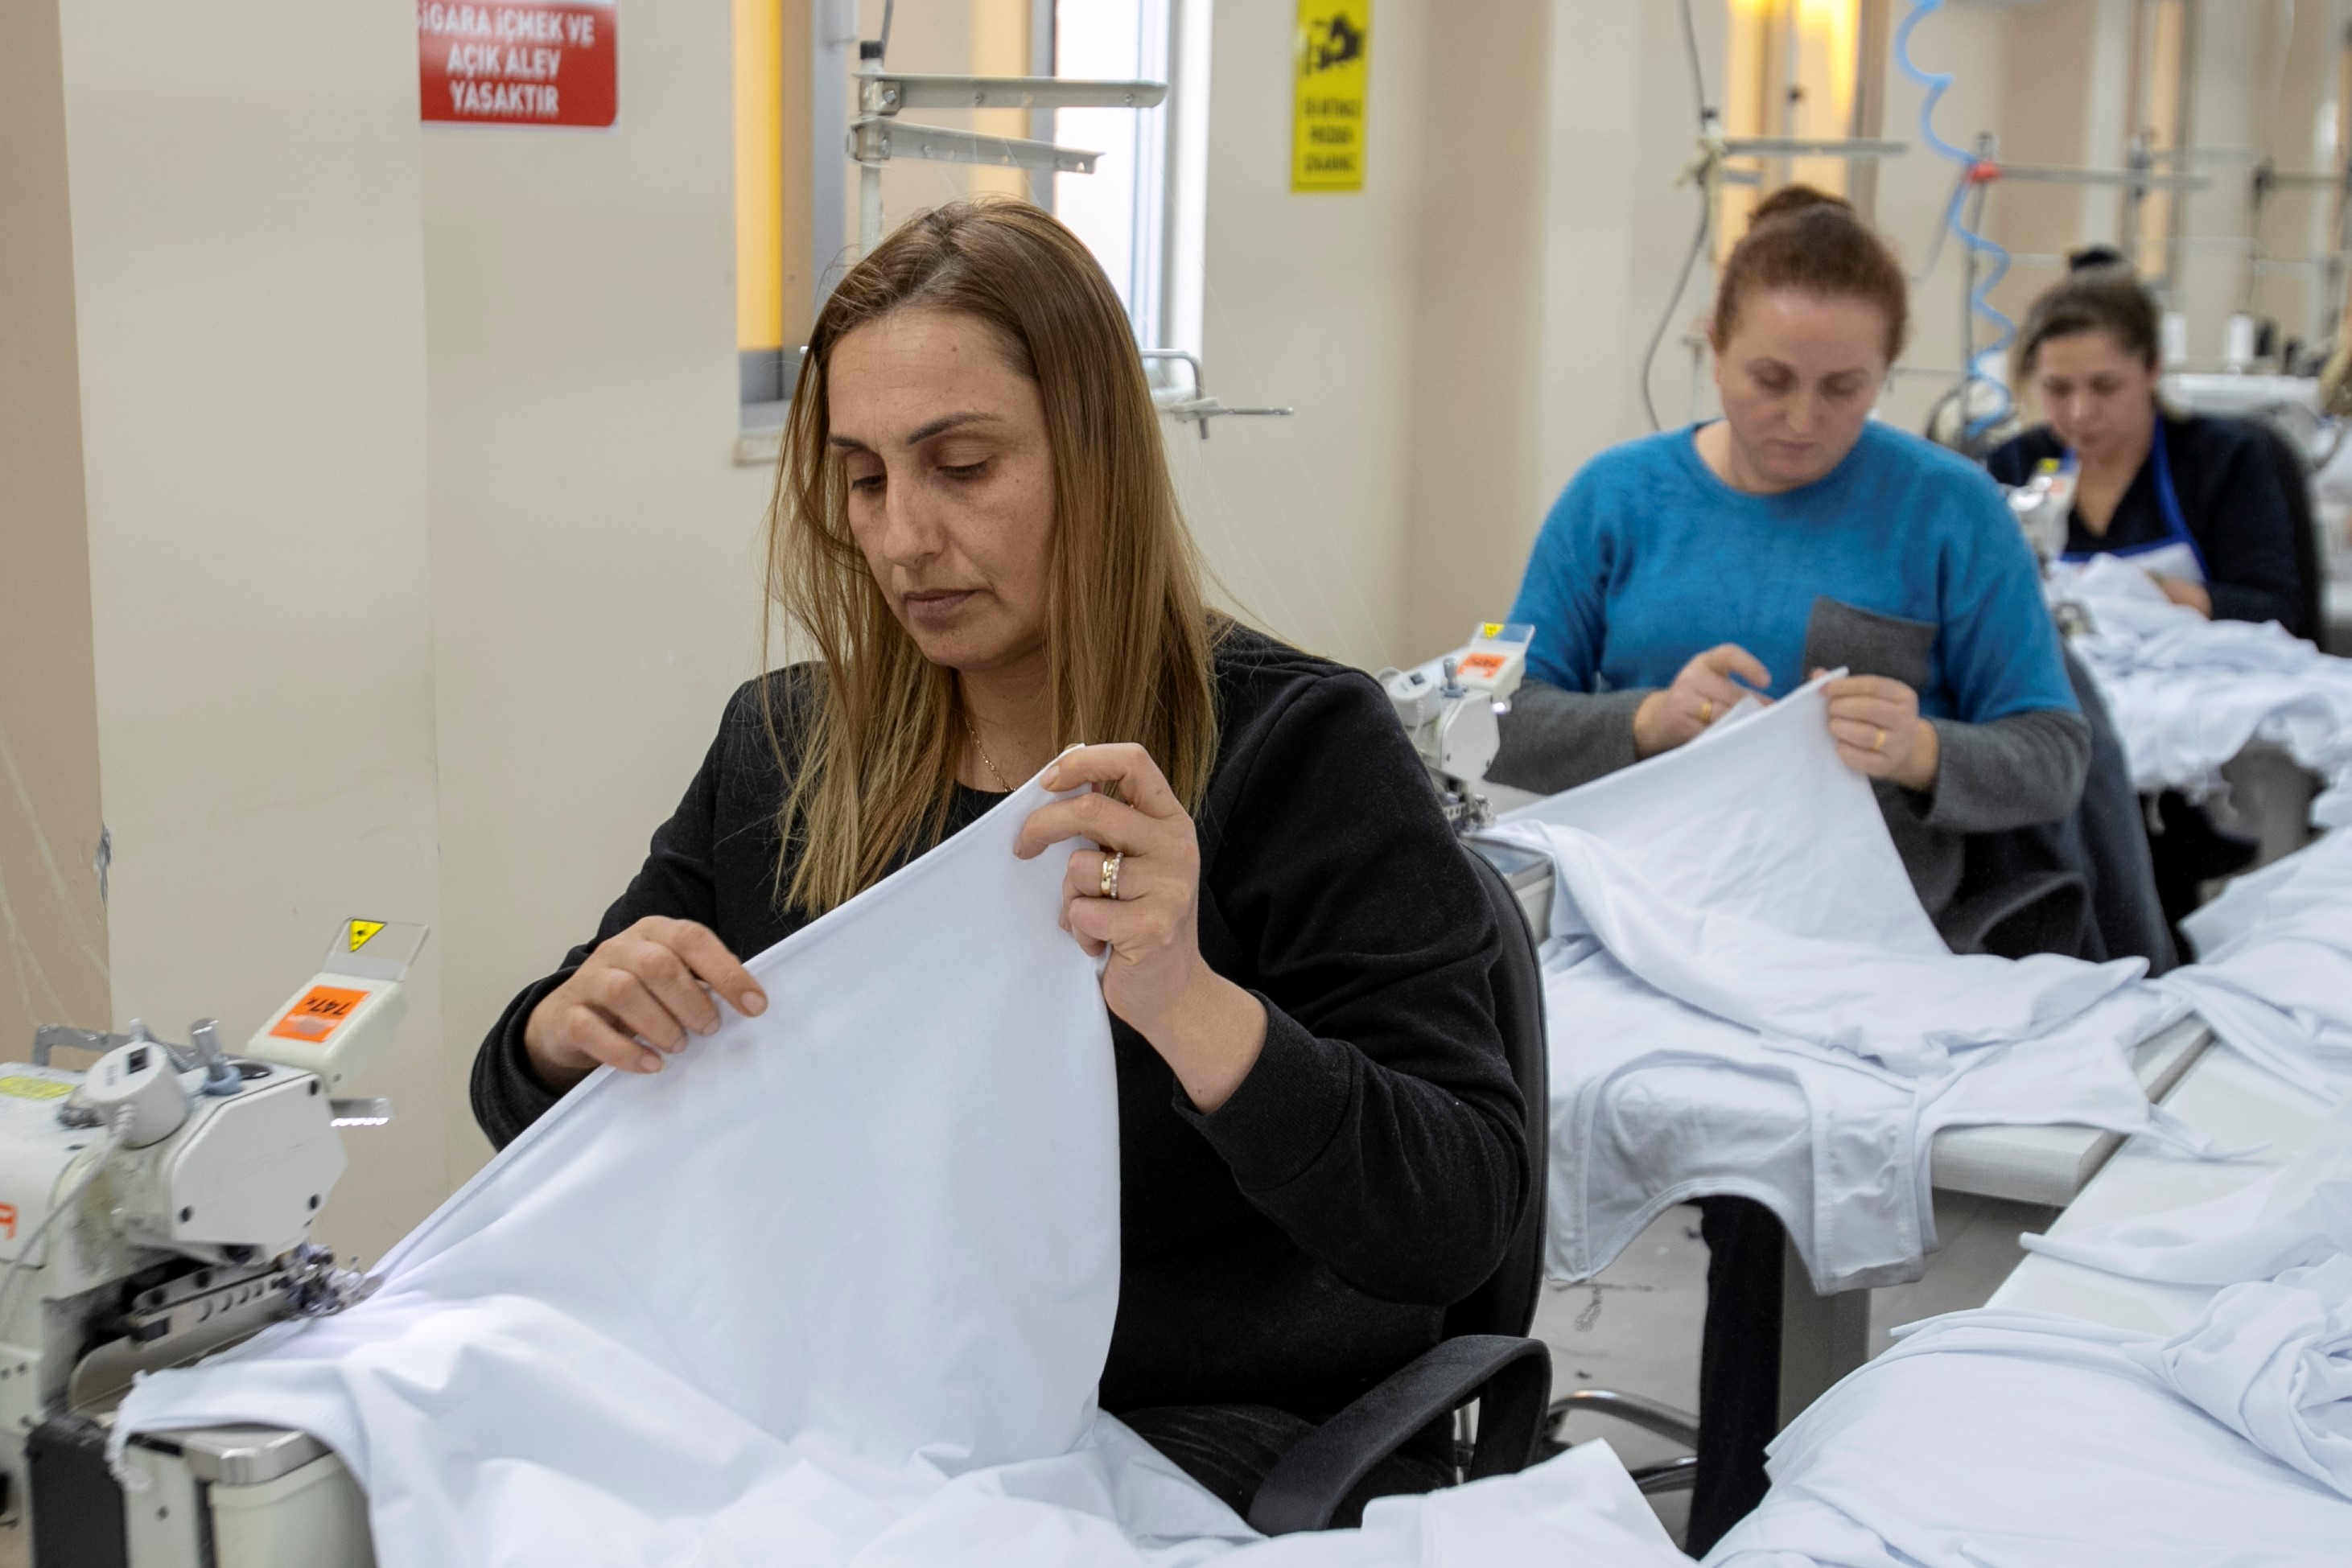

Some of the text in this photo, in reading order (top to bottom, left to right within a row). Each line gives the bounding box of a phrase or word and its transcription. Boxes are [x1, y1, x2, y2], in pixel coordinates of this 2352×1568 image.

[567, 14, 595, 45] VE
[447, 43, 561, 79] AÇIK ALEV
[451, 80, 559, 114] YASAKTIR
